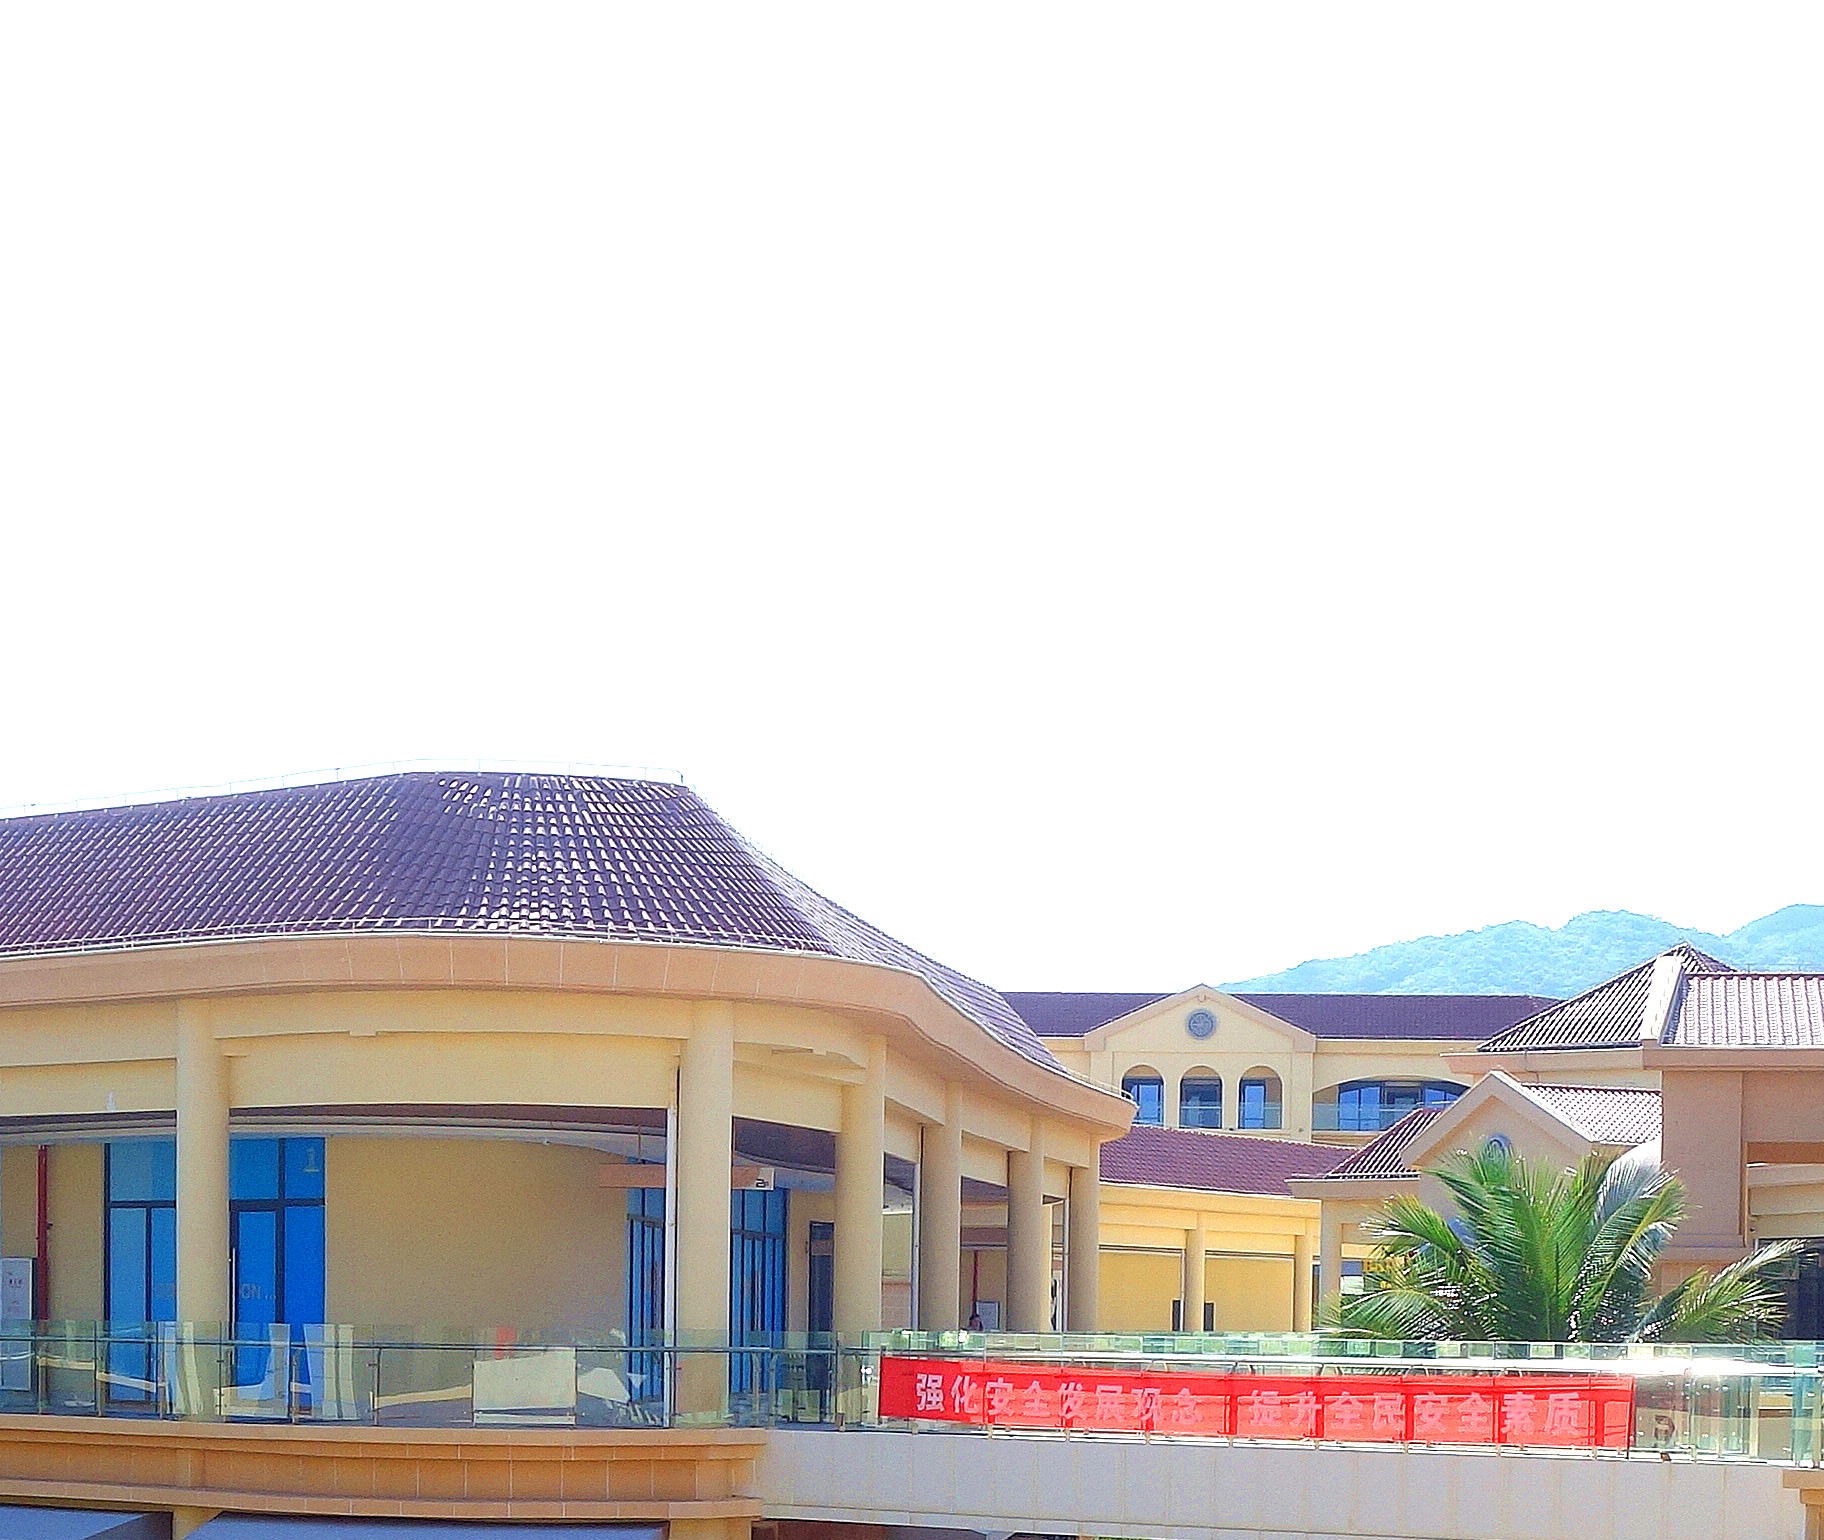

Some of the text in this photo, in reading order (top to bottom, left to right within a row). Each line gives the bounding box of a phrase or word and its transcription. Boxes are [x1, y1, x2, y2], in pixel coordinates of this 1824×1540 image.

[914, 1372, 1581, 1436] 强化安全发展观念 提升全民安全素质
